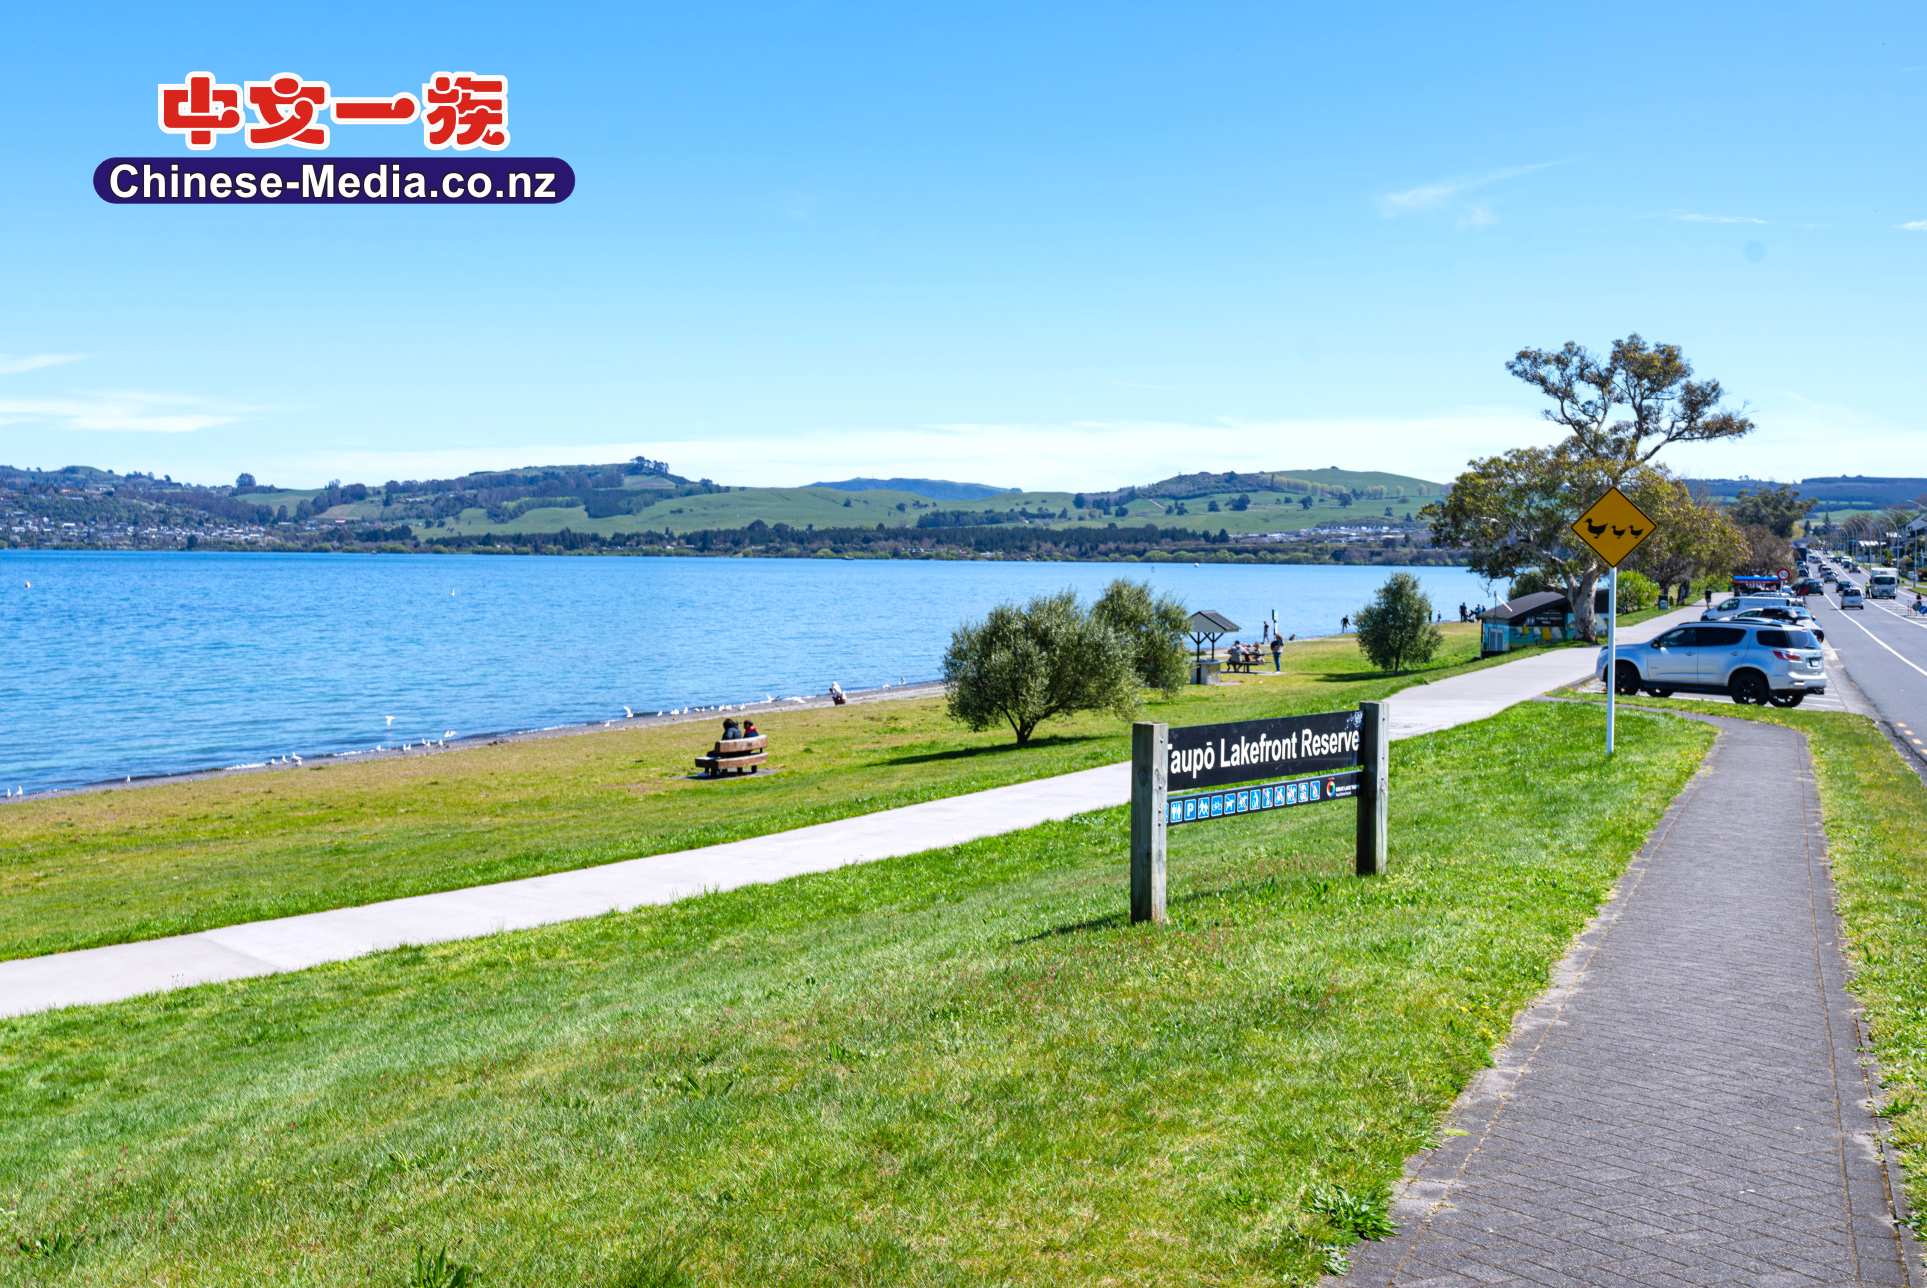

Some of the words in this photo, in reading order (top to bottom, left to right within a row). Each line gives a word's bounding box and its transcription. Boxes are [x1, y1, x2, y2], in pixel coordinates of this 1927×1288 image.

[1167, 741, 1215, 779] aupō
[1220, 733, 1297, 768] Lakefront
[1301, 729, 1360, 758] Reserve
